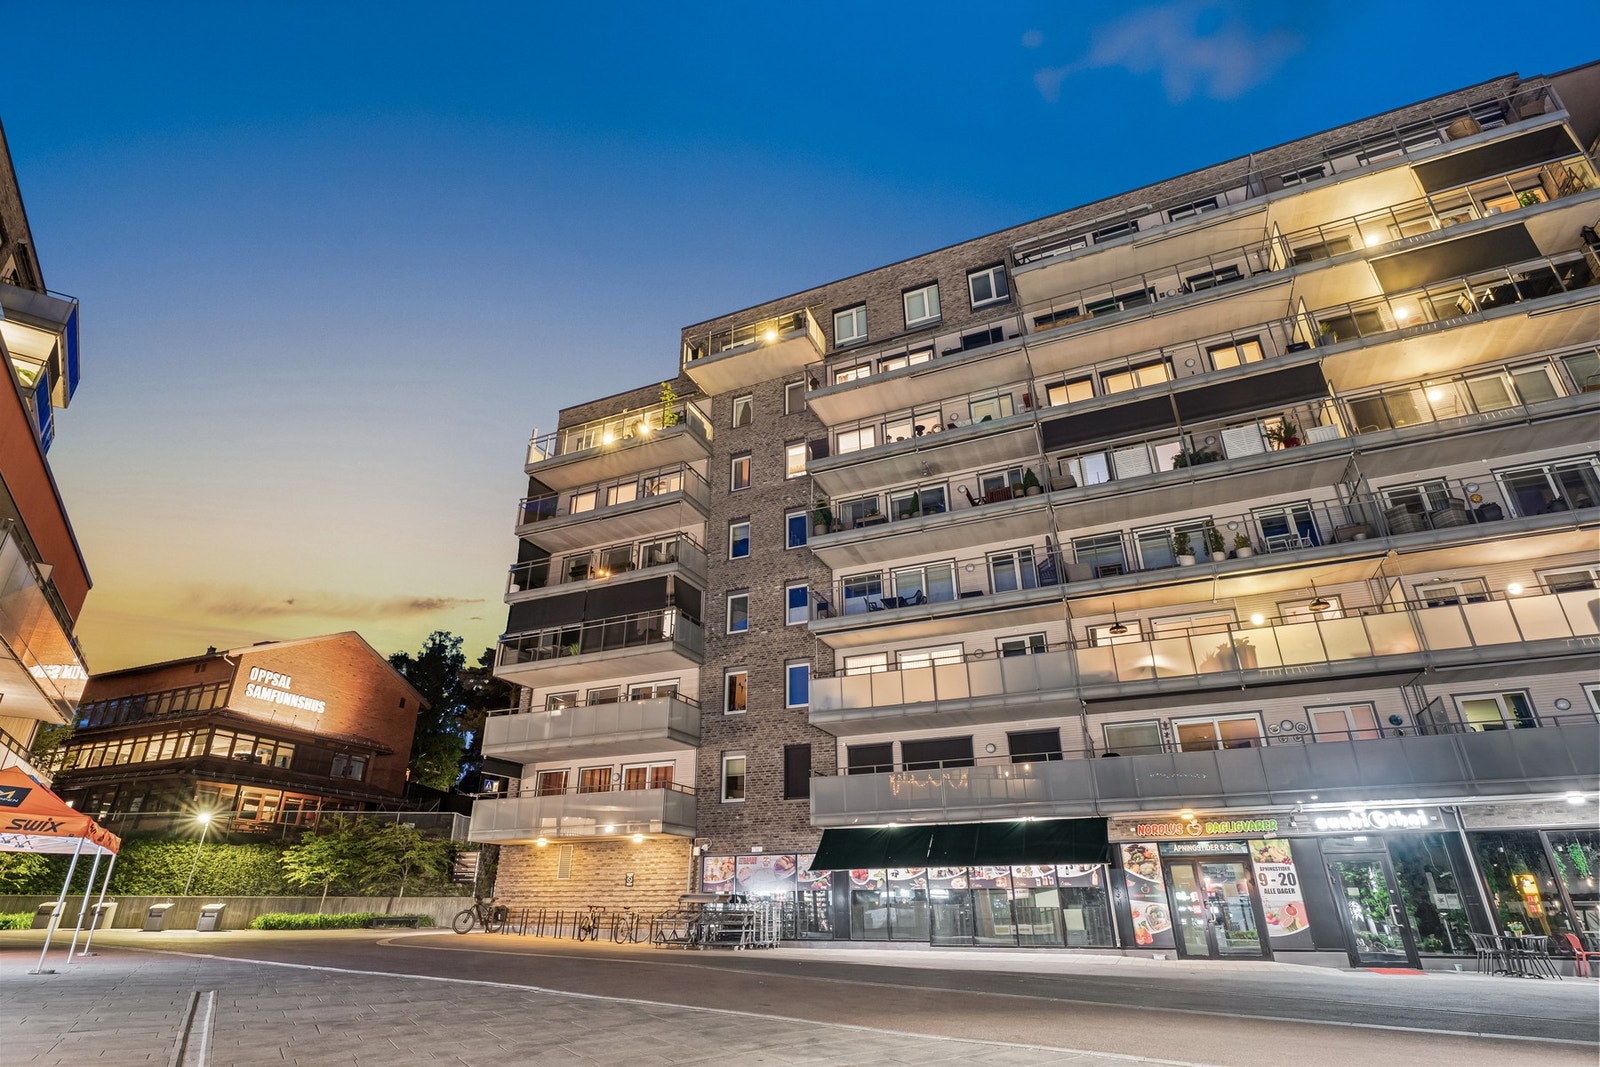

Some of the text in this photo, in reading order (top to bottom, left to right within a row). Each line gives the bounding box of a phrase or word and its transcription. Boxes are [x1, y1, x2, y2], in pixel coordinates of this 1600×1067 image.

[249, 666, 292, 690] OPPSAL
[245, 683, 326, 714] SAMFUNNSHUS
[1137, 819, 1278, 836] NORDLYS DAGLIGVARER
[1258, 872, 1269, 887] 9
[1278, 872, 1297, 886] 20
[1277, 887, 1296, 895] DAGER
